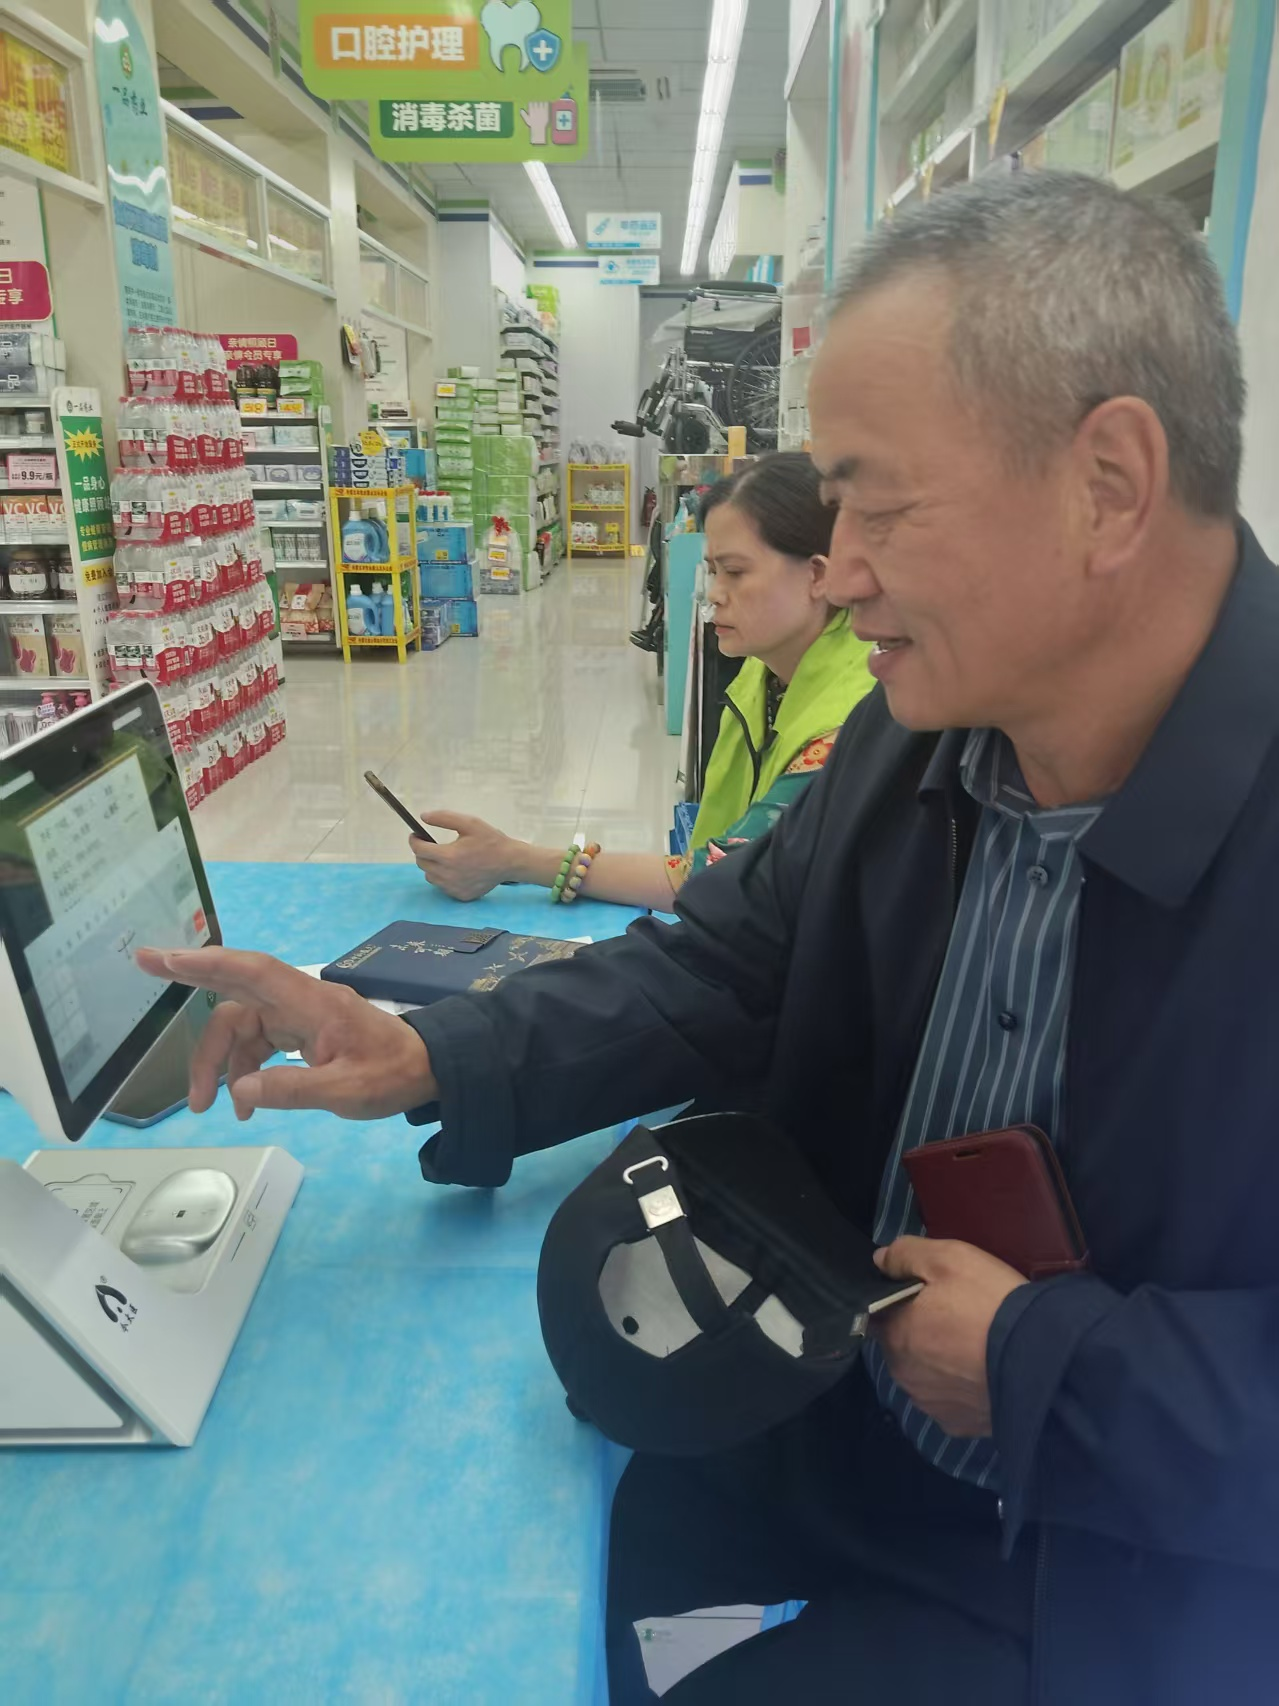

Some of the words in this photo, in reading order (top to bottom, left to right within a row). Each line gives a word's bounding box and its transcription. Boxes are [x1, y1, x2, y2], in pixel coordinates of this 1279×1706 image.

[331, 25, 465, 61] 口腔护理
[392, 102, 502, 132] 消毒杀菌
[3, 502, 25, 514] VC
[25, 502, 46, 514] VC
